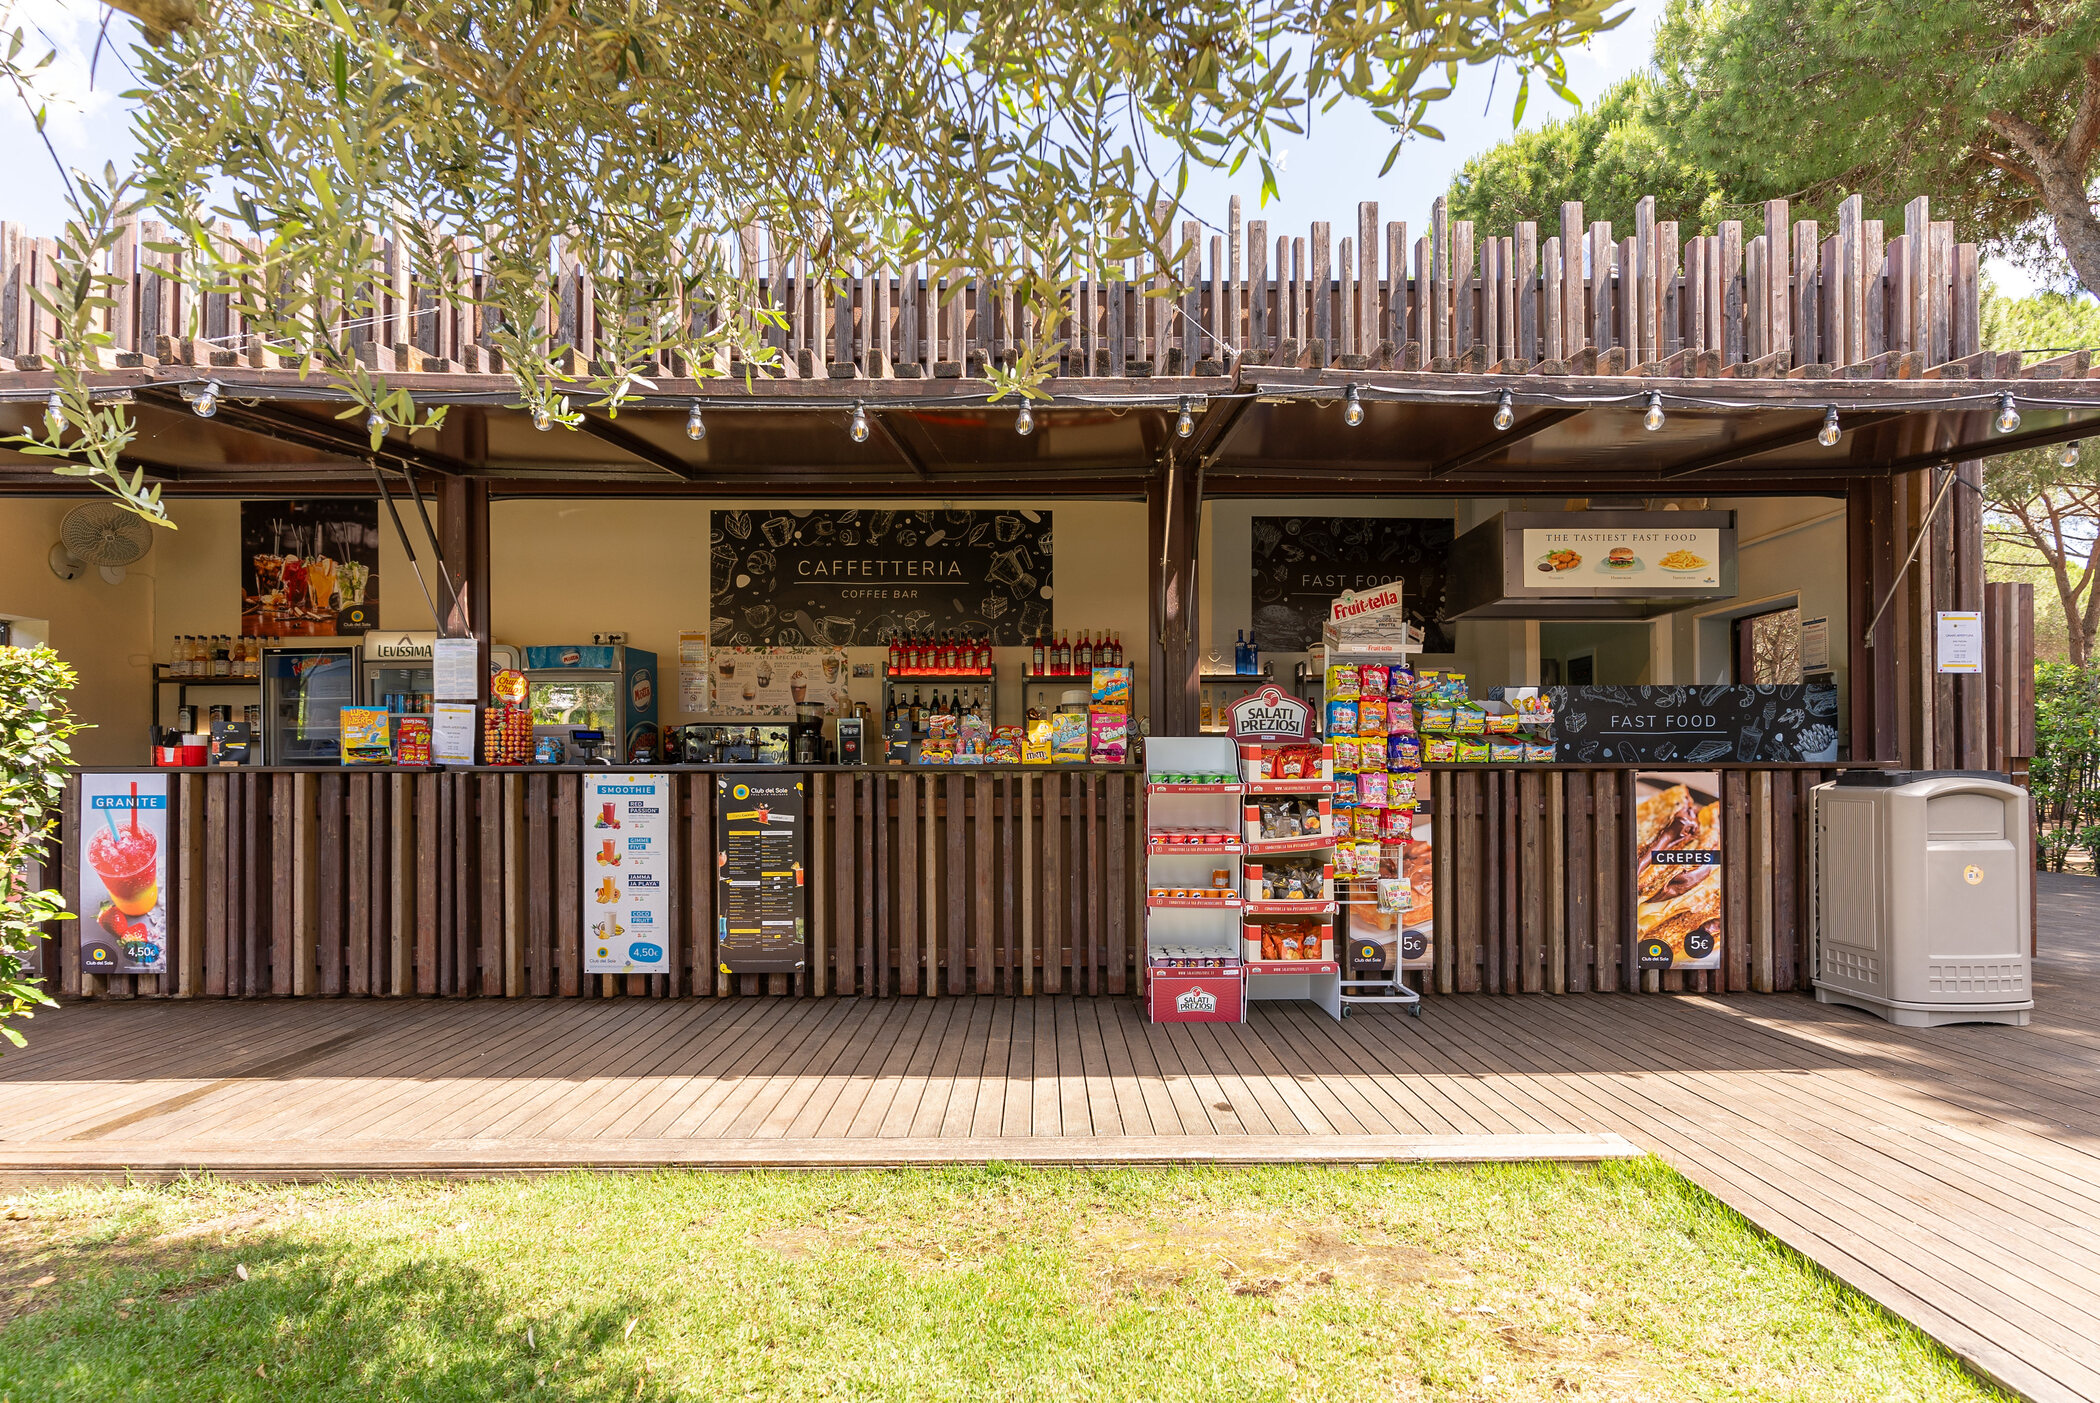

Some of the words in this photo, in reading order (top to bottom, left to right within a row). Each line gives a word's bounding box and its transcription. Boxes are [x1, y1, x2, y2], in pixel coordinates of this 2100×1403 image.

[1546, 534, 1569, 542] THE
[1573, 534, 1627, 542] TASTIEST
[1632, 534, 1659, 542] FAST
[1664, 534, 1697, 542] FOOD
[797, 560, 962, 576] CAFFETTERIA
[1302, 574, 1347, 587] FAST
[841, 590, 888, 599] COFFEE
[893, 590, 918, 599] BAR
[1333, 591, 1398, 620] Fruit-tella
[378, 645, 432, 657] LEVISSIMA
[1248, 708, 1294, 720] SALATI
[1241, 720, 1300, 732] PREZIOSI
[1611, 715, 1657, 728] FAST
[1666, 715, 1716, 728] FOOD
[601, 786, 651, 794] SMOOTHIE
[96, 797, 157, 807] GRANITE
[1656, 852, 1711, 863] CREPES
[1403, 937, 1421, 951] 5€
[1690, 935, 1708, 950] 5€
[128, 947, 156, 957] 4,50€
[633, 947, 659, 957] 4,50€
